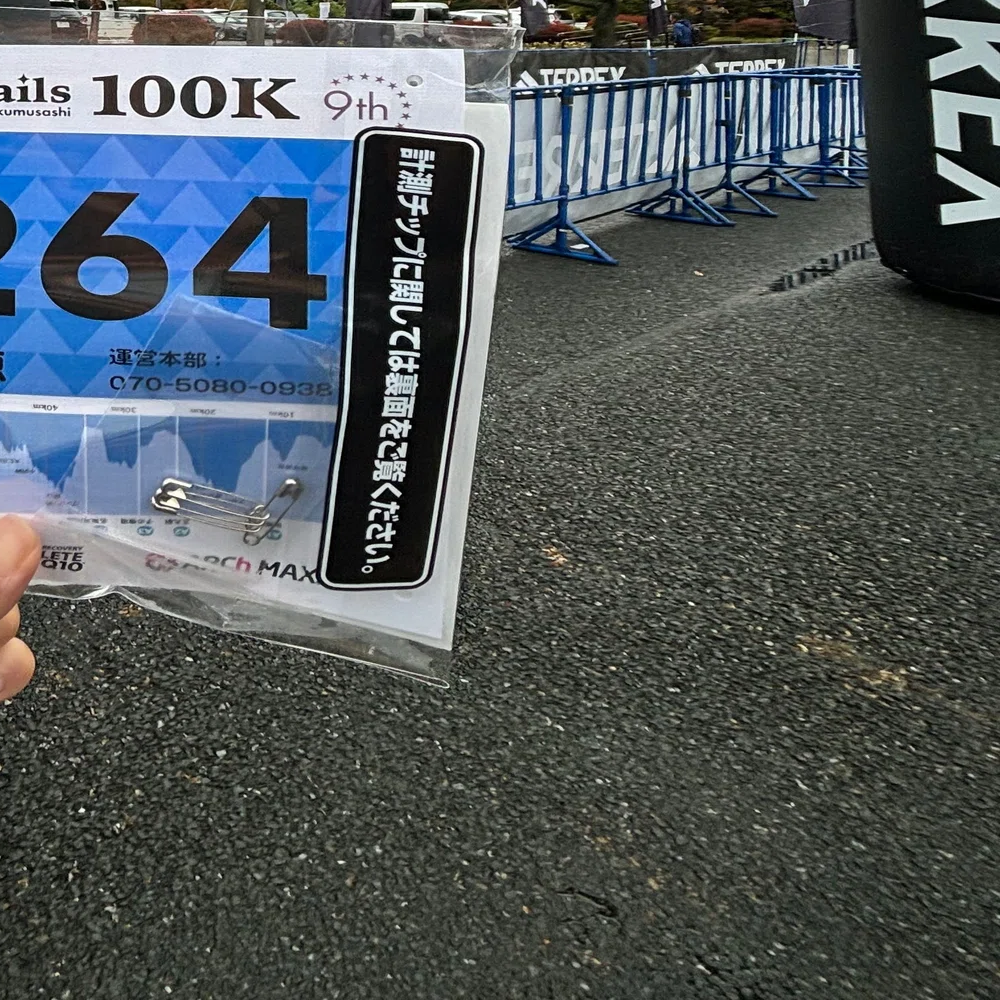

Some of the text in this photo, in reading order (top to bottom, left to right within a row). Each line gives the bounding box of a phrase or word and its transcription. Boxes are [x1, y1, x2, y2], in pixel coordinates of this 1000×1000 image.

[92, 74, 300, 120] 100K
[323, 90, 389, 121] 9th
[360, 147, 436, 575] 計測チップに関しては裏面をご覧ください。
[109, 375, 333, 397] 070-5080-0938
[32, 403, 59, 411] 40km
